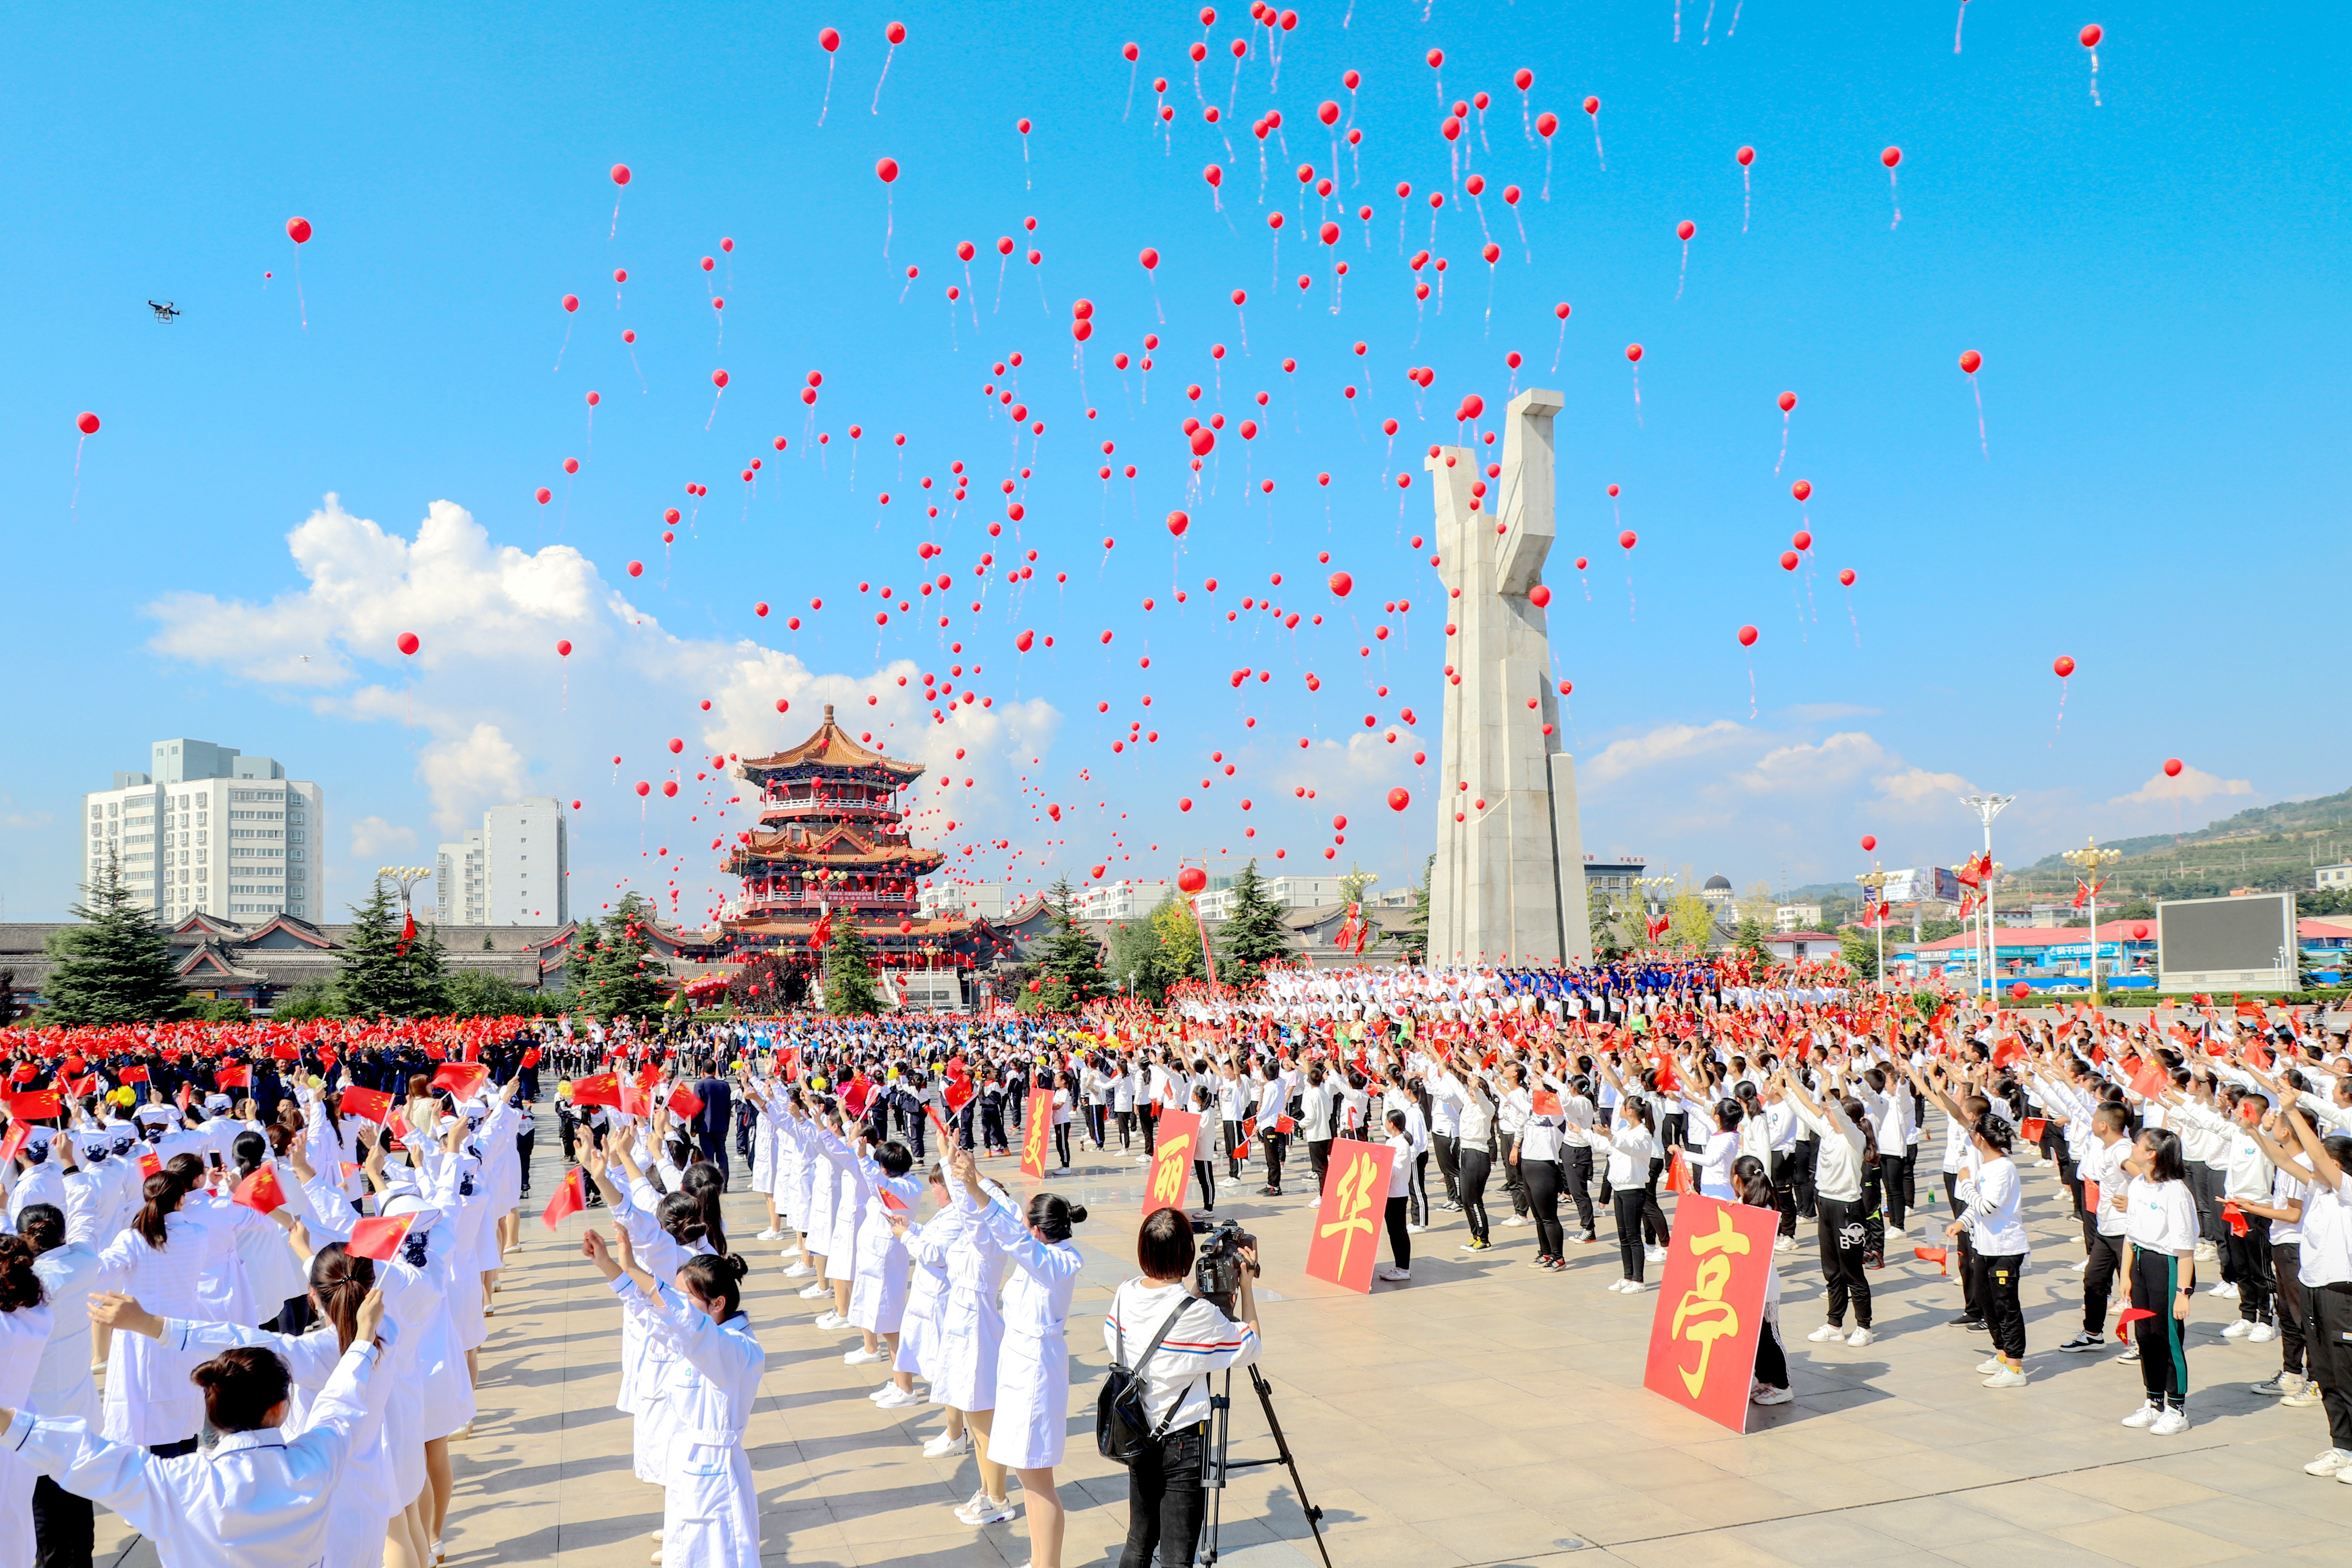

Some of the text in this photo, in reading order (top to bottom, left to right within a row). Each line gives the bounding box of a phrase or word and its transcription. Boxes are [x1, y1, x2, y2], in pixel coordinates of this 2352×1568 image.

[1023, 1091, 1046, 1177] 美
[1153, 1133, 1190, 1205] 丽
[1320, 1152, 1378, 1282] 华
[1671, 1205, 1751, 1400] 亭
